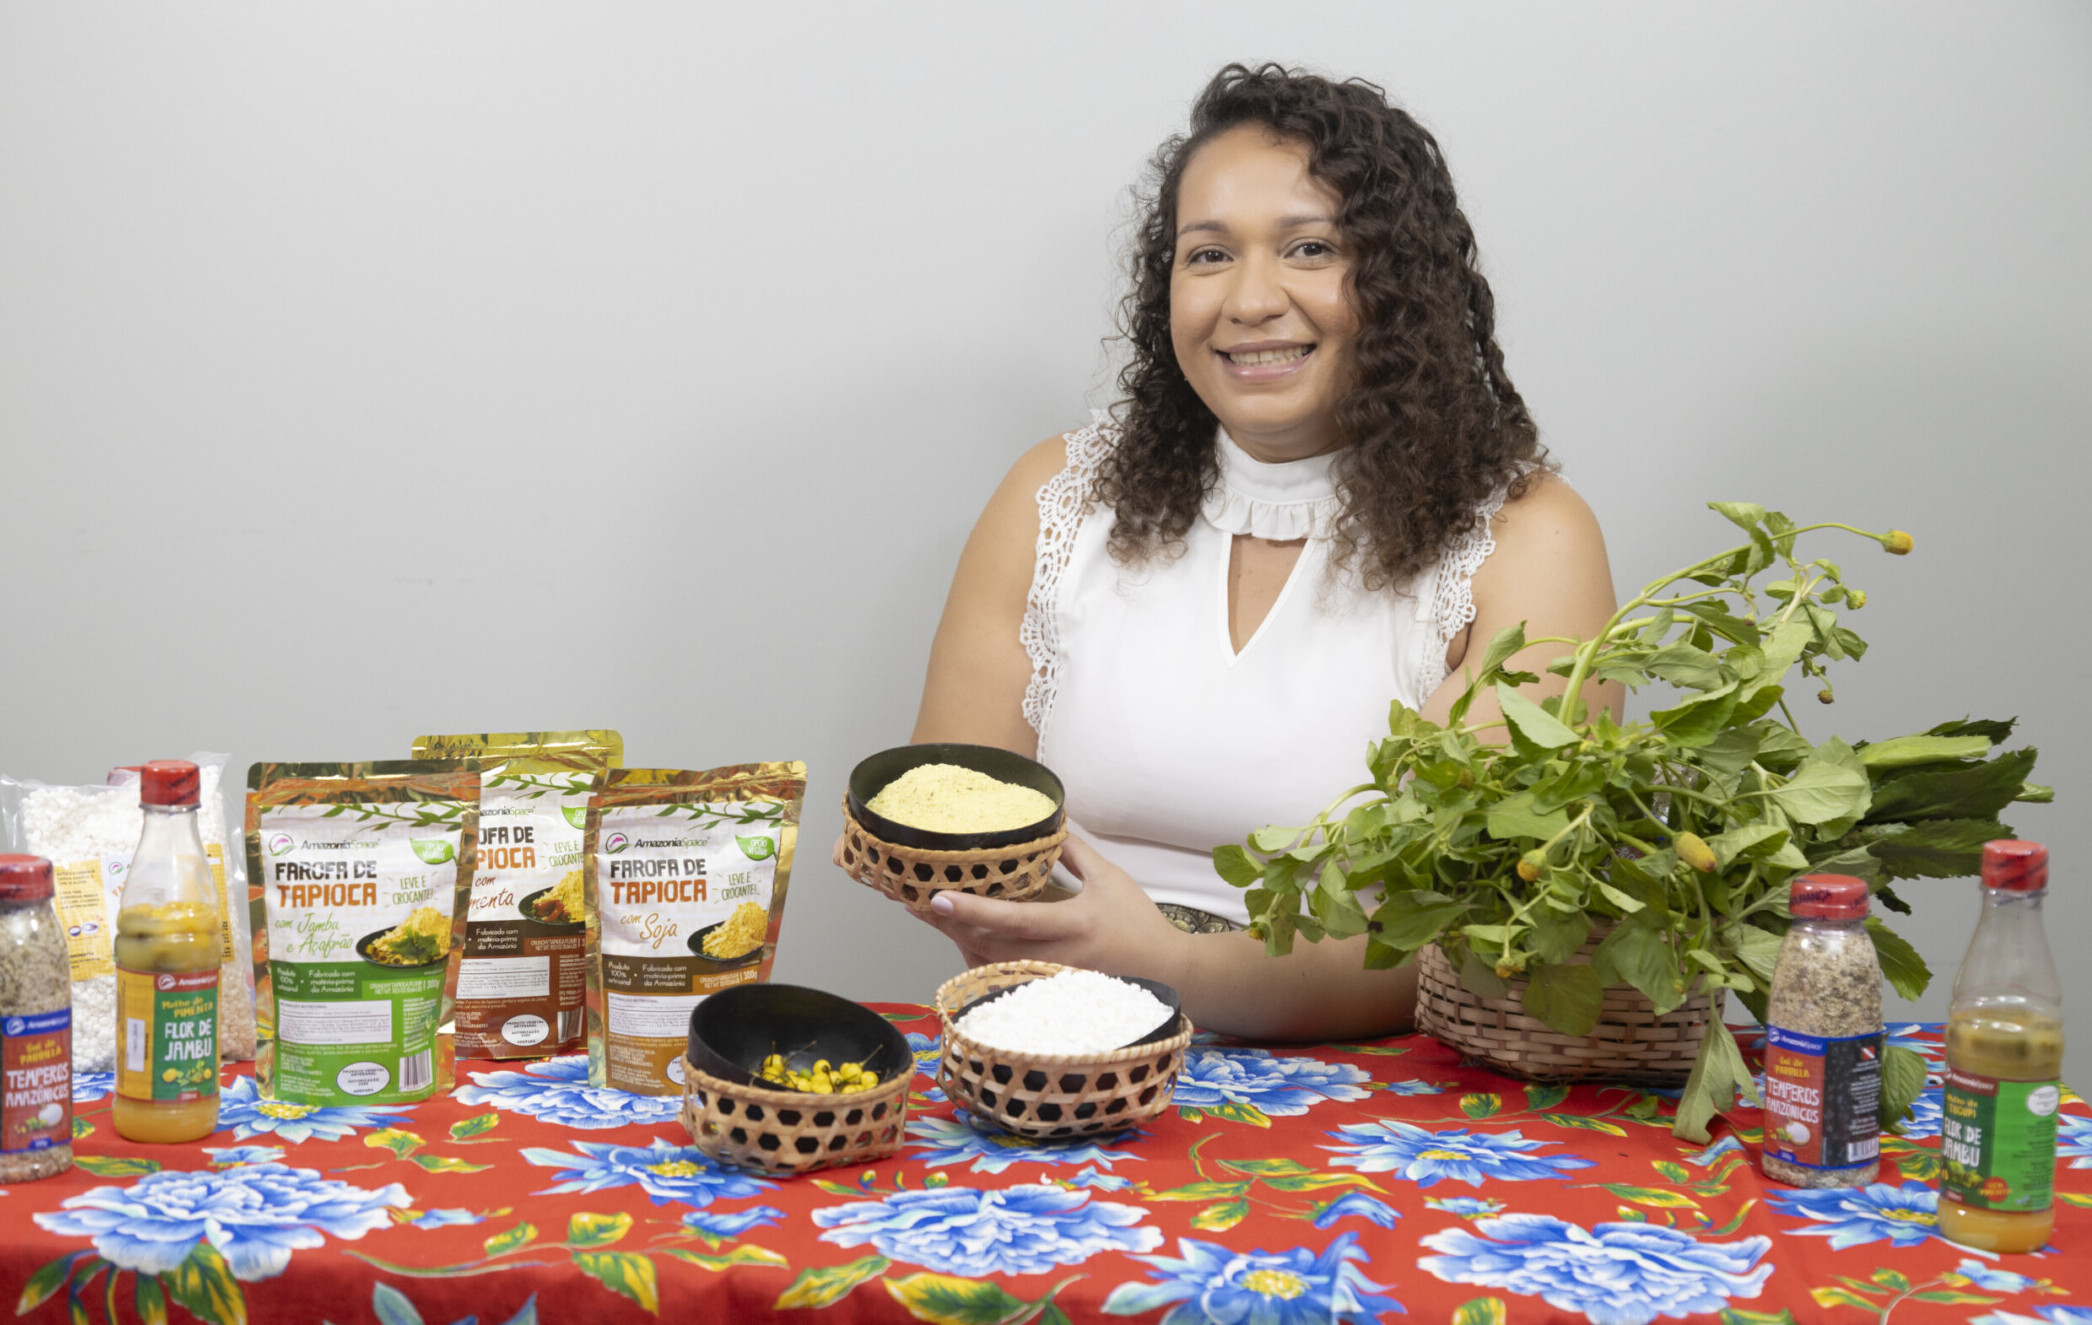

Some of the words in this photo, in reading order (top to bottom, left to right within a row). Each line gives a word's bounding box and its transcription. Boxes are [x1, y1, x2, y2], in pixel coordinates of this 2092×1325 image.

[479, 826, 509, 845] OFA
[513, 826, 534, 844] DE
[635, 837, 709, 849] AmazoniaSpace
[554, 842, 571, 853] LEVE
[574, 840, 579, 851] E
[475, 847, 536, 871] PIOCA
[275, 861, 348, 881] FAROFA
[354, 860, 378, 878] DE
[610, 859, 679, 878] FAROFA
[684, 858, 707, 875] DE
[400, 877, 419, 890] LEVE
[421, 876, 427, 887] E
[475, 876, 496, 887] com
[729, 873, 745, 885] LEVE
[746, 872, 751, 883] E
[277, 883, 377, 908] TAPIOCA
[392, 888, 434, 905] CROCANTE!
[469, 888, 515, 910] menta
[610, 879, 707, 905] TAPIOCA
[721, 884, 757, 901] CROCANTE!
[275, 919, 292, 929] com
[297, 912, 339, 933] Jambu
[620, 914, 642, 925] com
[640, 912, 678, 950] Soja
[476, 928, 505, 936] Fabricado
[478, 936, 518, 944] matéria-prima
[286, 944, 294, 953] e
[299, 932, 354, 958] Açafrão
[488, 942, 517, 950] Amazônia
[308, 969, 339, 978] Fabricado
[608, 961, 630, 971] Produto
[611, 970, 627, 978] 100%
[642, 964, 672, 972] Fabricado
[310, 978, 354, 988] matéria-prima
[644, 972, 686, 981] matéria-prima
[644, 979, 652, 987] da
[653, 979, 686, 987] Amazônia
[311, 986, 320, 994] da
[321, 985, 354, 993] Amazônia
[162, 1000, 190, 1010] Molho
[174, 1001, 213, 1018] PIMENTA
[165, 1021, 194, 1039] FLOR
[199, 1018, 212, 1036] DE
[164, 1037, 212, 1061] JAMBU
[1779, 1056, 1791, 1066] Sal
[1793, 1058, 1803, 1067] de
[6, 1062, 69, 1090] TEMPEROS
[1775, 1065, 1810, 1078] PARRILLA
[5, 1082, 69, 1108] AMAZÔNICOS
[1767, 1076, 1820, 1106] TEMPEROS
[1765, 1096, 1820, 1124] AMAZÔNICOS
[1949, 1103, 1977, 1119] TUCUPI
[1944, 1116, 1962, 1140] FLOR
[1966, 1125, 1982, 1145] DE
[1943, 1137, 1981, 1168] JAMBU
